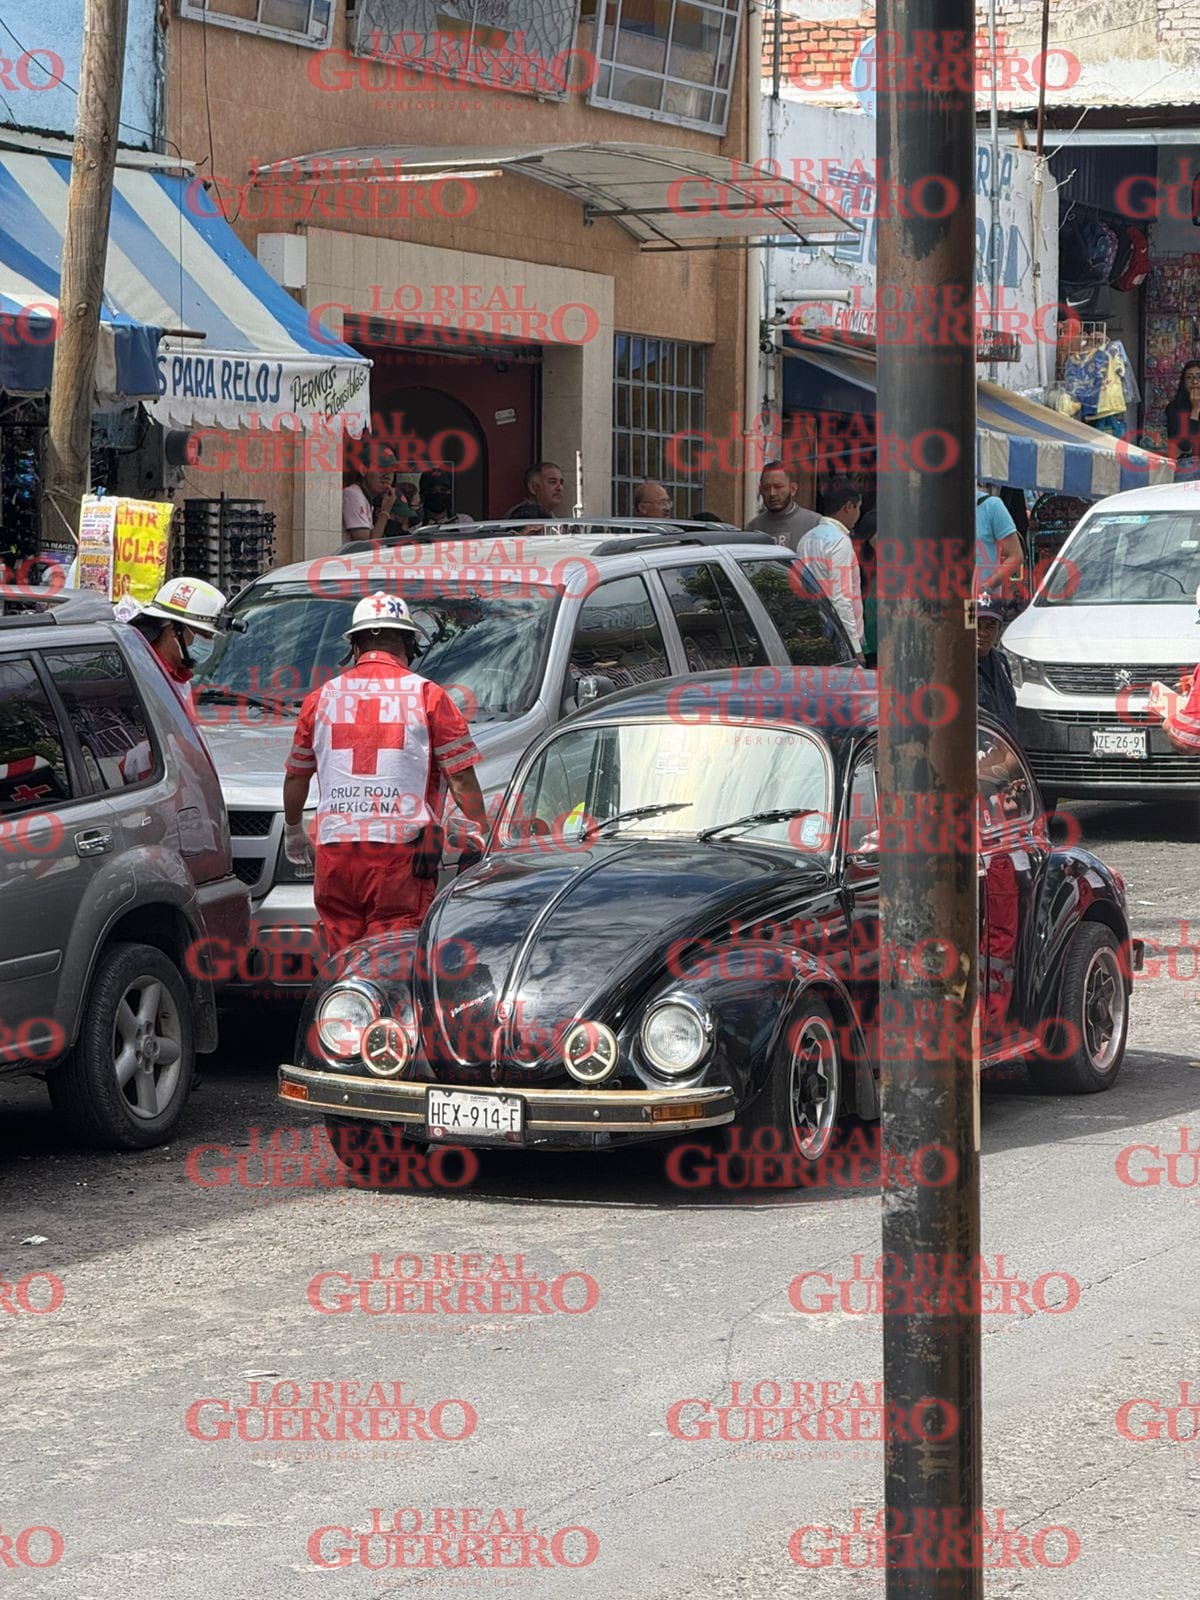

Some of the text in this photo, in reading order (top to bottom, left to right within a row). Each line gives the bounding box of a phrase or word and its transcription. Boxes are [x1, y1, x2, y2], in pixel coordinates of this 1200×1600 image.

[835, 306, 876, 333] ENMICA
[172, 356, 216, 399] PARA
[221, 358, 283, 404] RELOJ
[292, 365, 337, 413] PERNOS
[331, 786, 400, 799] CRUZ ROJA
[330, 801, 401, 814] MEXICANA
[431, 1102, 519, 1131] HEX-914-F
